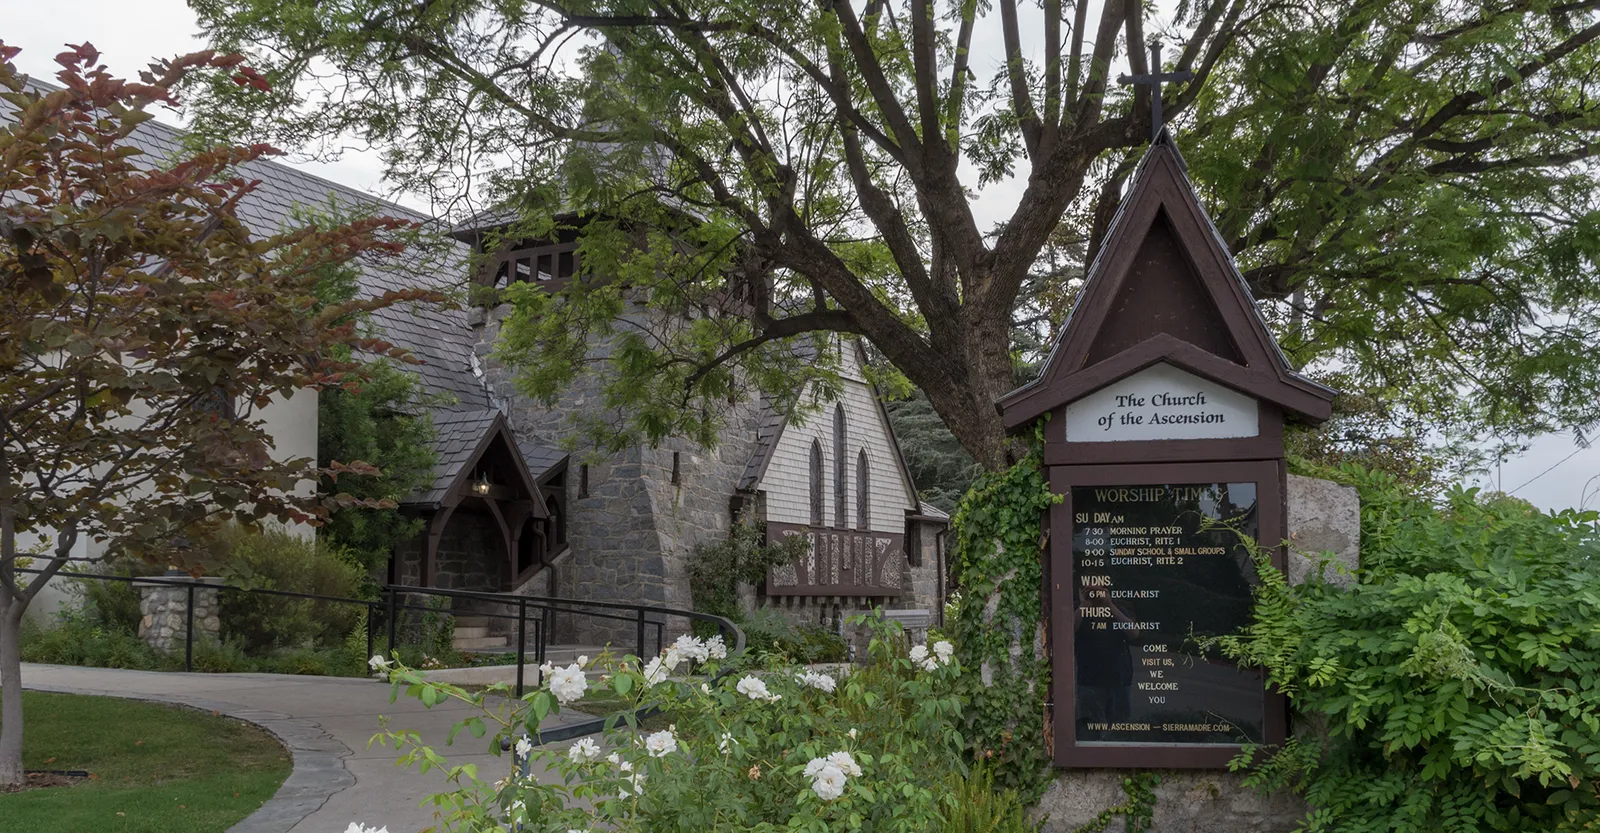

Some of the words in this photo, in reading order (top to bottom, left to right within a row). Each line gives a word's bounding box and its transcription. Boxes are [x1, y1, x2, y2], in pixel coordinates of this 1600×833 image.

[1115, 393, 1145, 408] The
[1151, 391, 1206, 407] Church
[1097, 411, 1116, 431] of
[1120, 411, 1143, 425] the
[1148, 411, 1225, 425] Ascension
[1095, 488, 1164, 503] WORSHIP
[1173, 487, 1223, 501] TIMES
[1110, 527, 1147, 535] MORNING
[1150, 526, 1182, 535] PRAYER
[1110, 537, 1152, 547] EUCHRIST,
[1155, 537, 1175, 545] RITE
[1109, 548, 1136, 556] SUNDAY
[1137, 547, 1166, 556] SCHOOL
[1167, 547, 1172, 556] &
[1174, 547, 1197, 555] SMALL
[1197, 547, 1226, 555] GROUPS
[1111, 557, 1153, 567] EUCHRIST,
[1156, 557, 1176, 565] RITE
[1177, 557, 1184, 565] 2
[1111, 590, 1160, 599] EUCHARIST
[1079, 607, 1114, 618] THURS.
[1091, 622, 1096, 630] 7
[1096, 622, 1107, 630] AM
[1112, 622, 1160, 630] EUCHARIST
[1143, 644, 1168, 653] COME
[1141, 658, 1160, 666] VISIT
[1162, 658, 1175, 667] US,
[1149, 670, 1164, 679] WE
[1137, 682, 1179, 691] WELCOME
[1148, 696, 1166, 704] YOU
